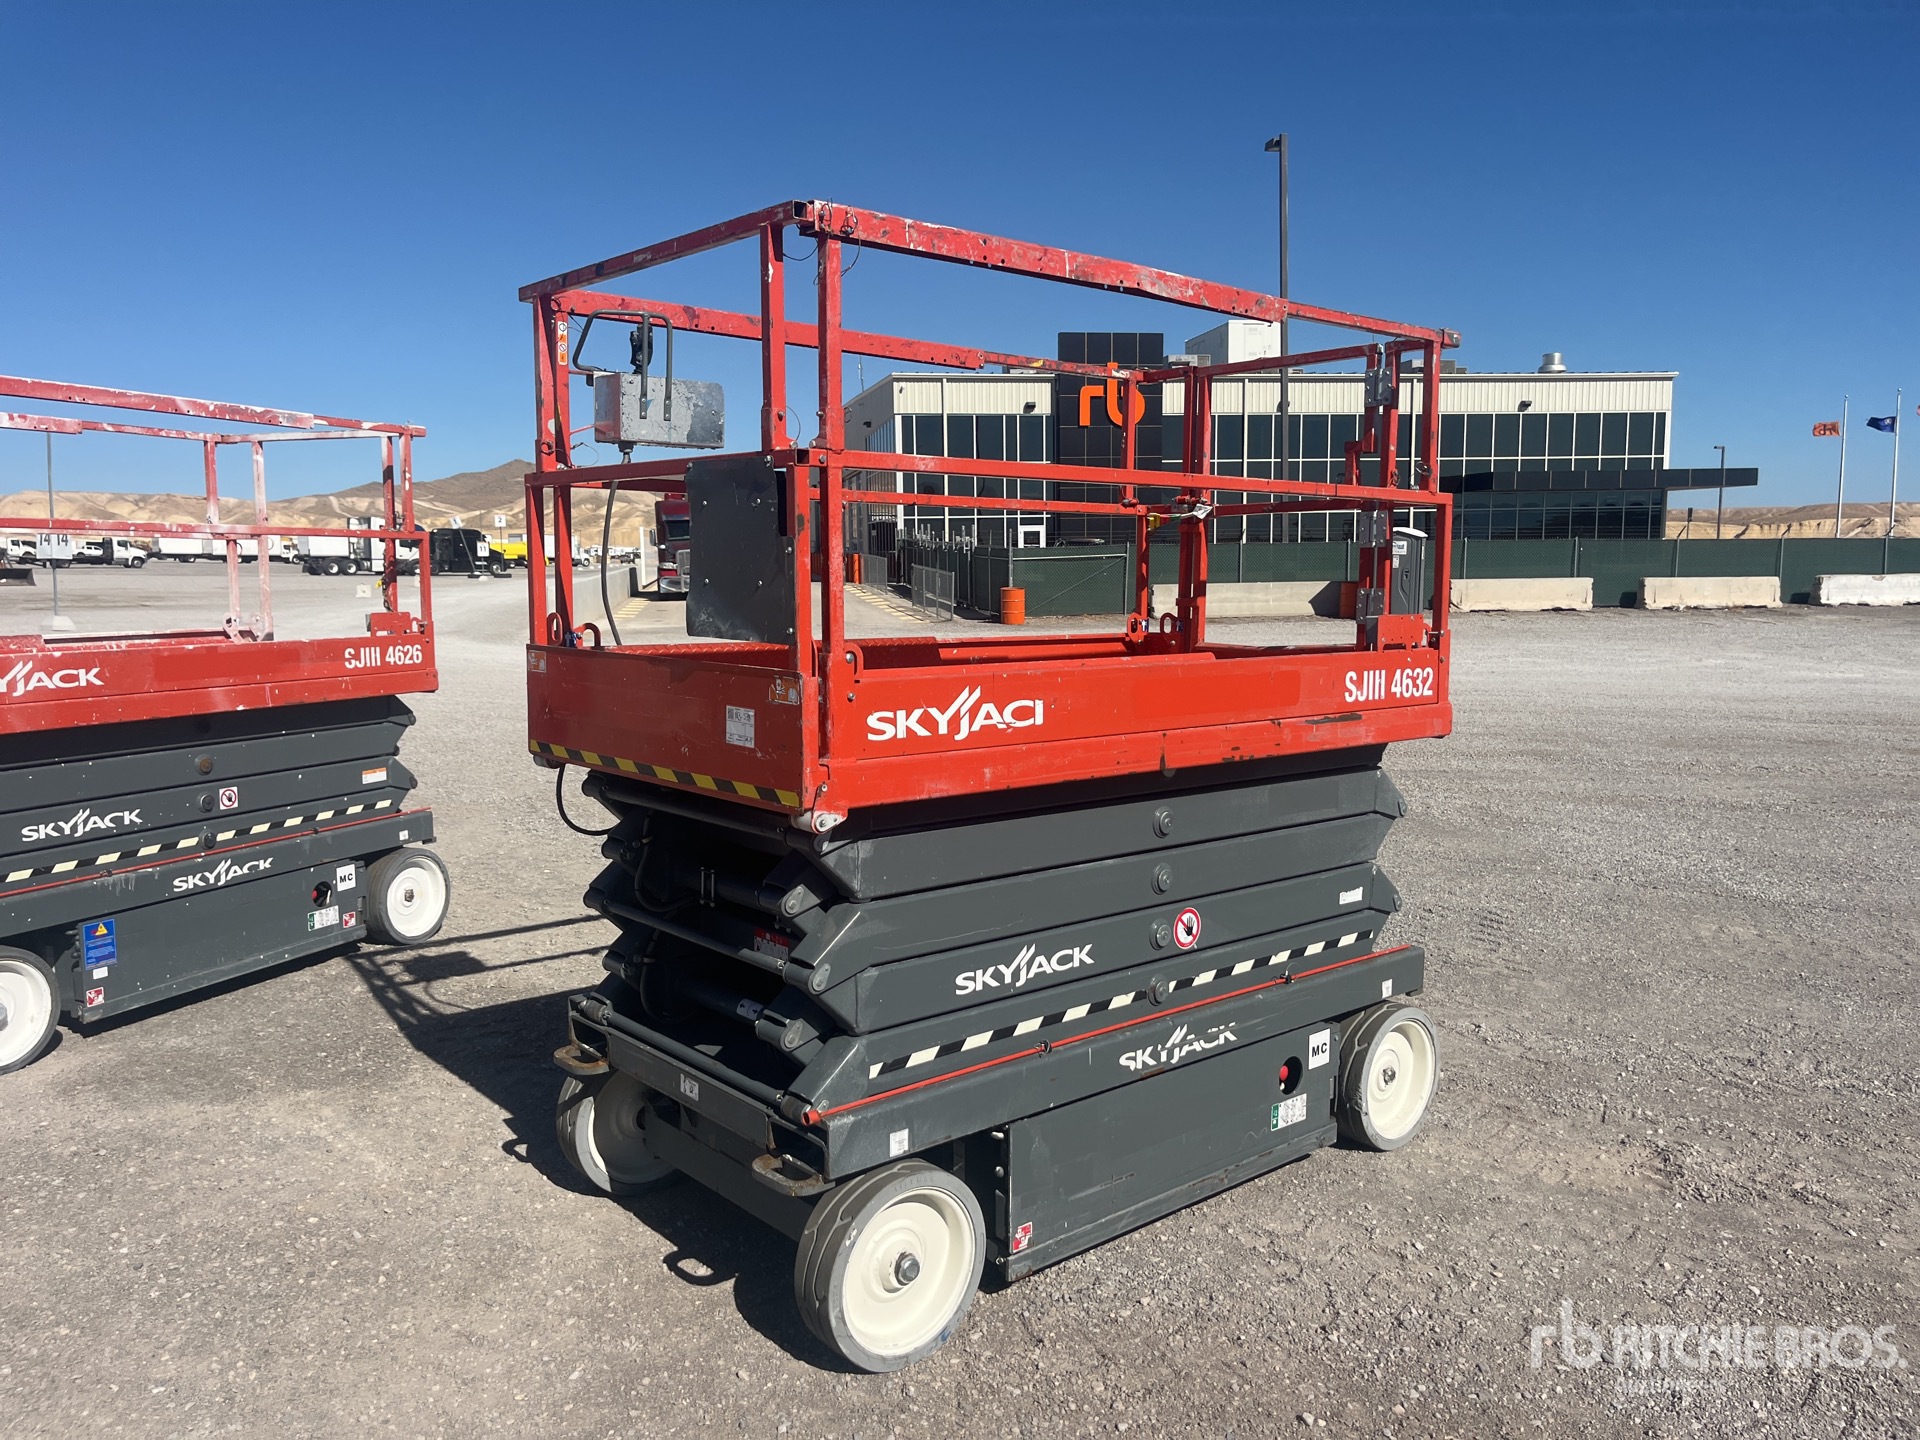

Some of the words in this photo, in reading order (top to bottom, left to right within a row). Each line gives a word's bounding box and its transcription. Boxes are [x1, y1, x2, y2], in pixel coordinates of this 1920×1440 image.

[57, 534, 68, 546] 14
[385, 644, 423, 666] 4626
[1391, 667, 1434, 699] 4632
[21, 808, 143, 842] SKYJACK
[173, 858, 274, 892] SKYJACK
[339, 873, 354, 884] MC
[955, 943, 1095, 996] SKYJACK
[1119, 1021, 1238, 1072] SKYJACK
[1311, 1042, 1328, 1058] MC
